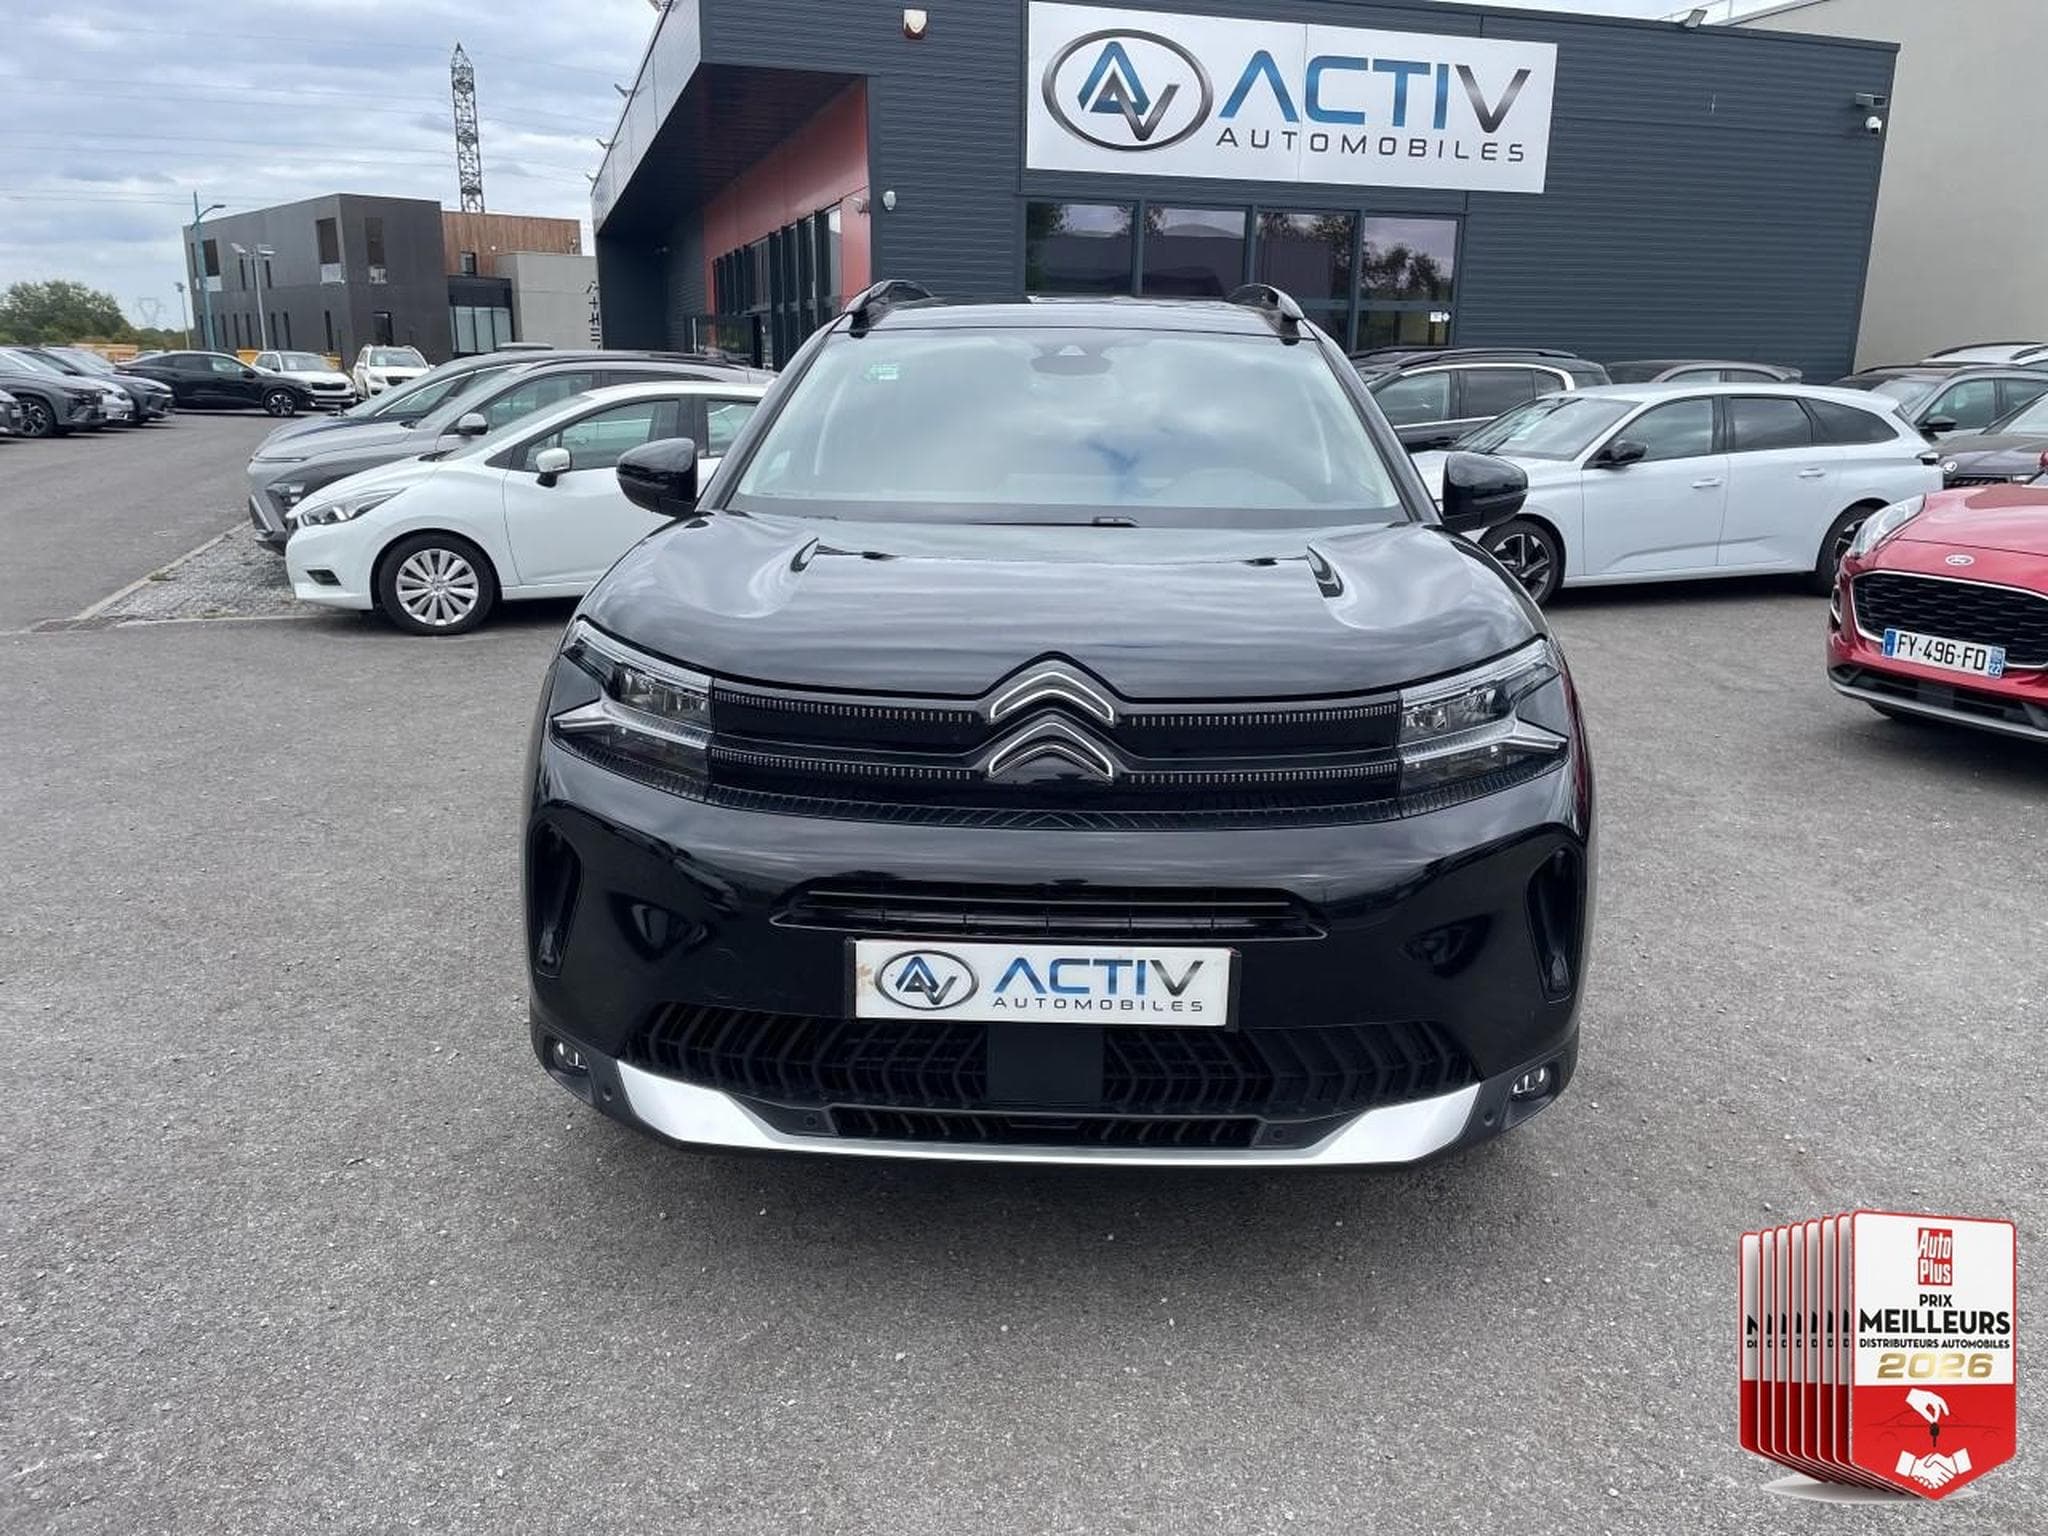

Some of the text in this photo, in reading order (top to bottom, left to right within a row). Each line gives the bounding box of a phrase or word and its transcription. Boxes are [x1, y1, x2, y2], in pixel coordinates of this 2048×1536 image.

[1218, 49, 1532, 134] ACTIV
[1216, 127, 1525, 163] AUTOMOBILES
[993, 957, 1204, 998] ACTIV
[992, 997, 1204, 1012] AUTOMOBILES
